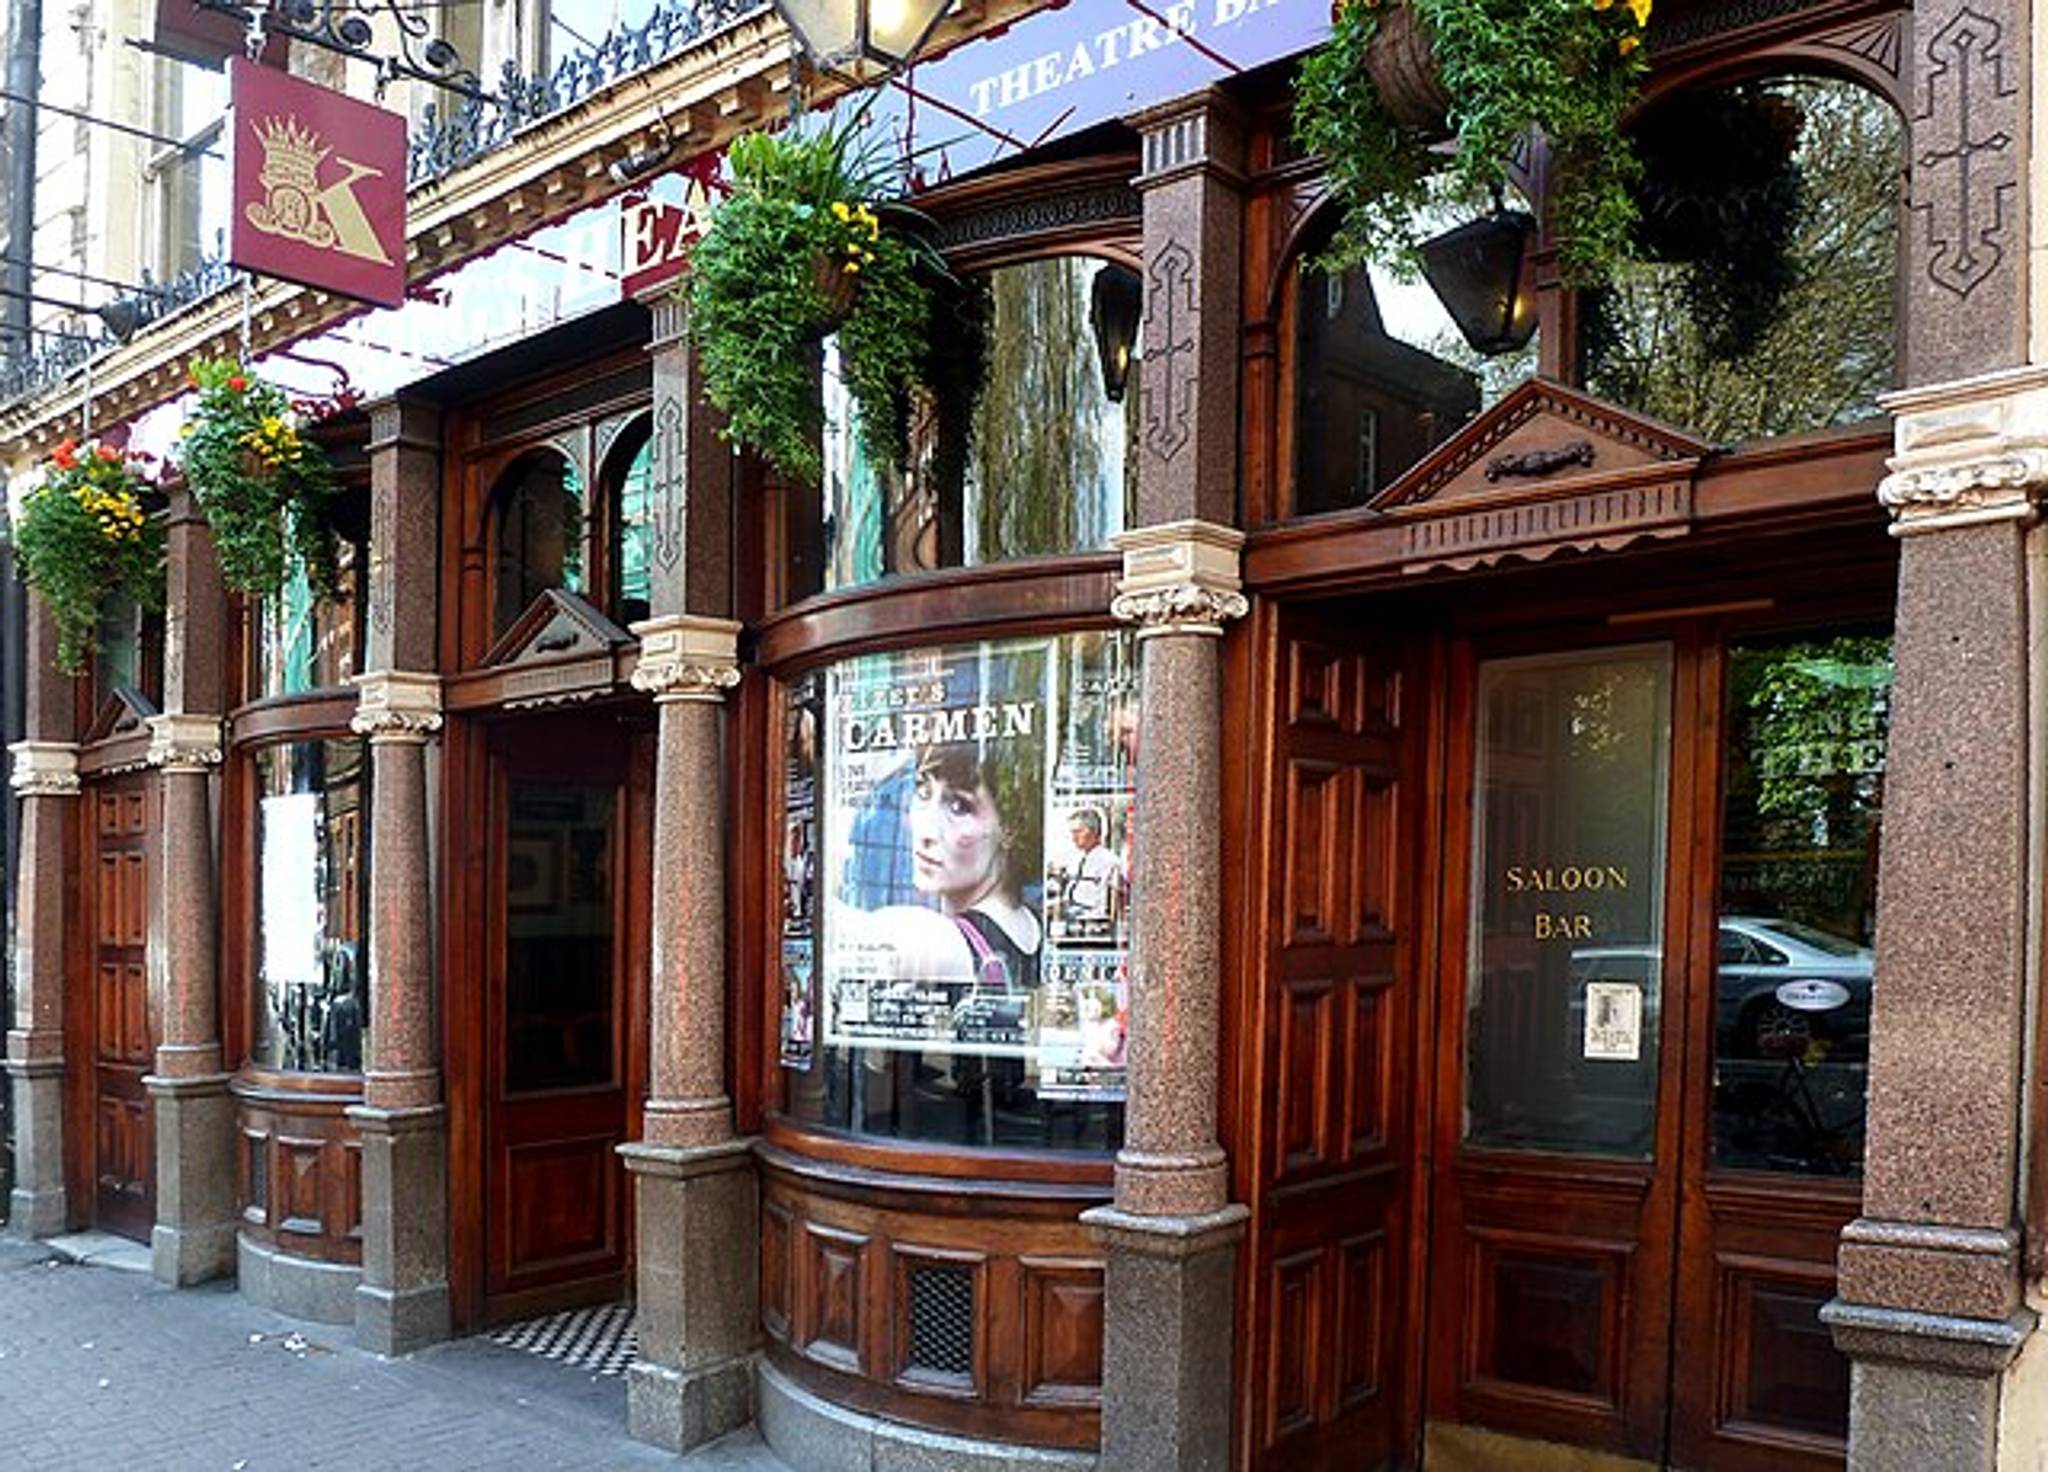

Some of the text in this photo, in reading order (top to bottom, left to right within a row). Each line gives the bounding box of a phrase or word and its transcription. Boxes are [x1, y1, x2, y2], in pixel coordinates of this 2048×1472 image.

[969, 5, 1198, 119] THEATRE
[842, 700, 1036, 752] CARMEN
[1505, 866, 1629, 892] SALOON
[1534, 914, 1593, 939] BAR
